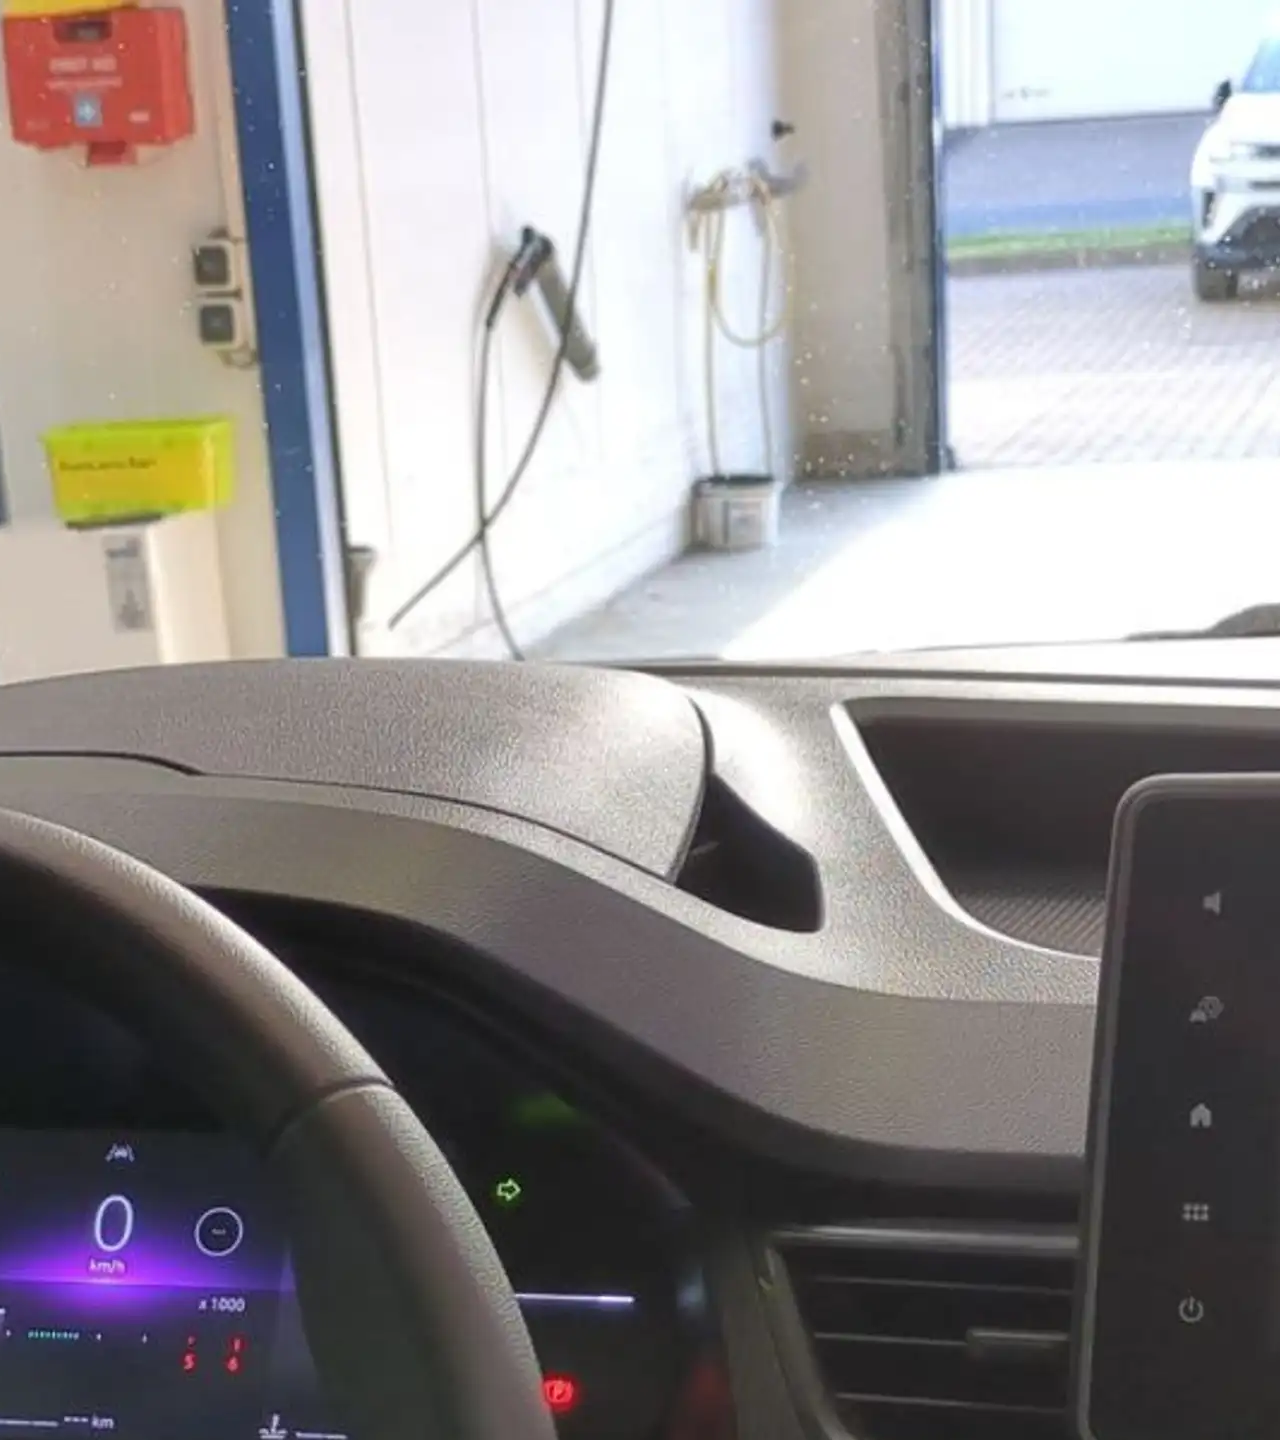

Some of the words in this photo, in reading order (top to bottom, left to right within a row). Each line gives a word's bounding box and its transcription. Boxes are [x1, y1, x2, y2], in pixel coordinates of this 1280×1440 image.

[95, 1195, 133, 1251] 0
[89, 1258, 126, 1275] km/h
[211, 1297, 246, 1312] 1000
[91, 1413, 115, 1429] km
